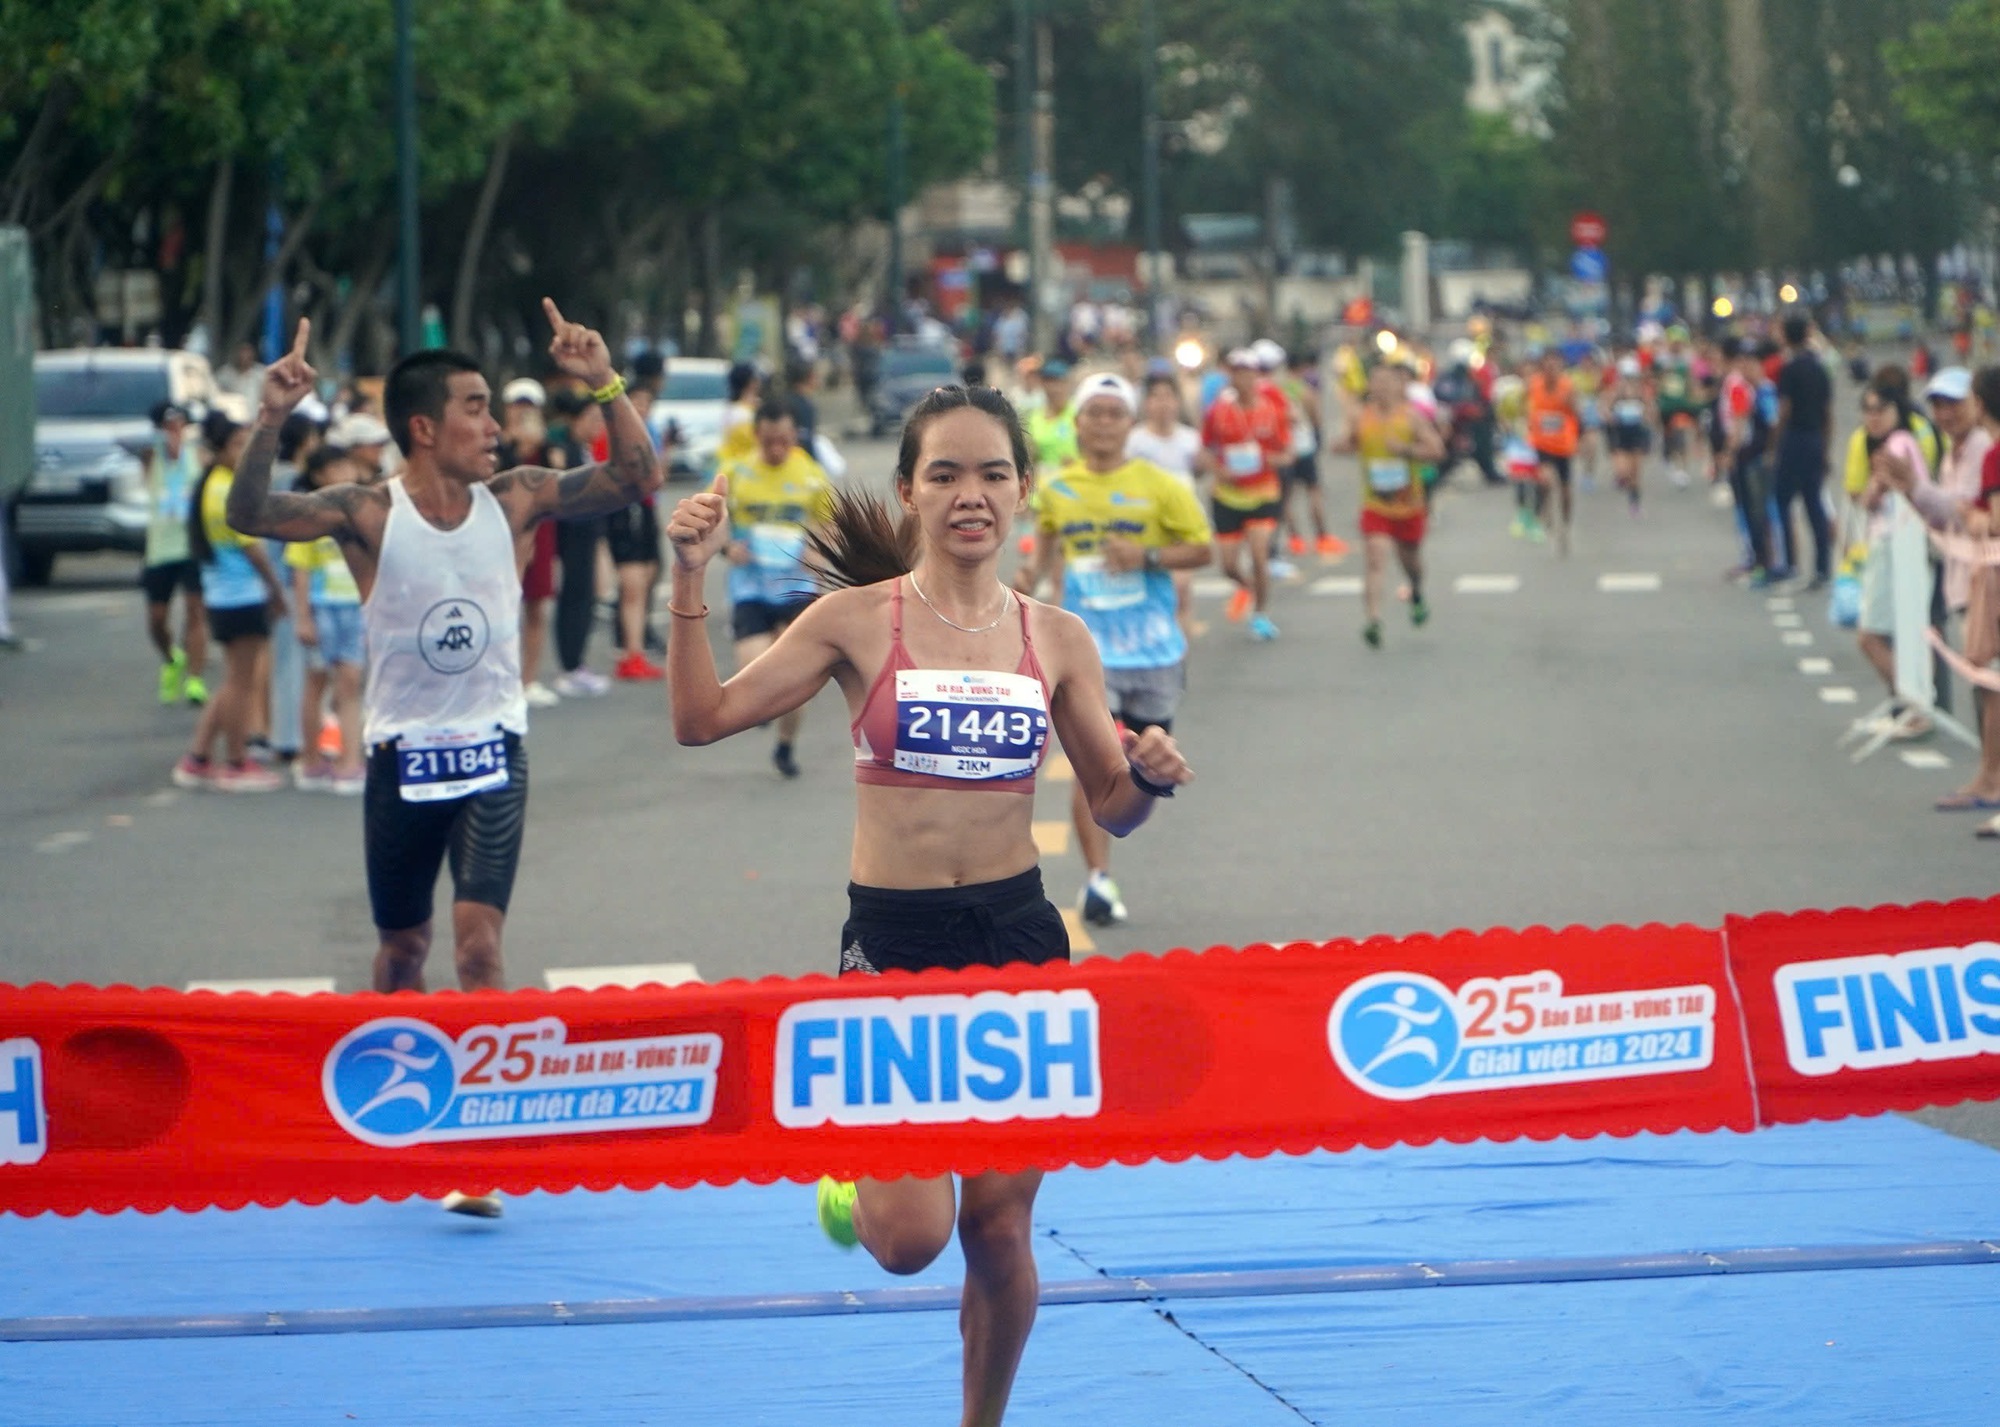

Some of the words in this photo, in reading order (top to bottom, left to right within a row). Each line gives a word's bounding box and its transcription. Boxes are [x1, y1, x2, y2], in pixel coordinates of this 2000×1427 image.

[907, 705, 1032, 747] 21443
[406, 744, 495, 777] 21184
[956, 759, 992, 773] 21KM
[792, 1009, 1093, 1108] FINISH
[1623, 1030, 1692, 1062] 2024
[620, 1083, 693, 1114] 2024
